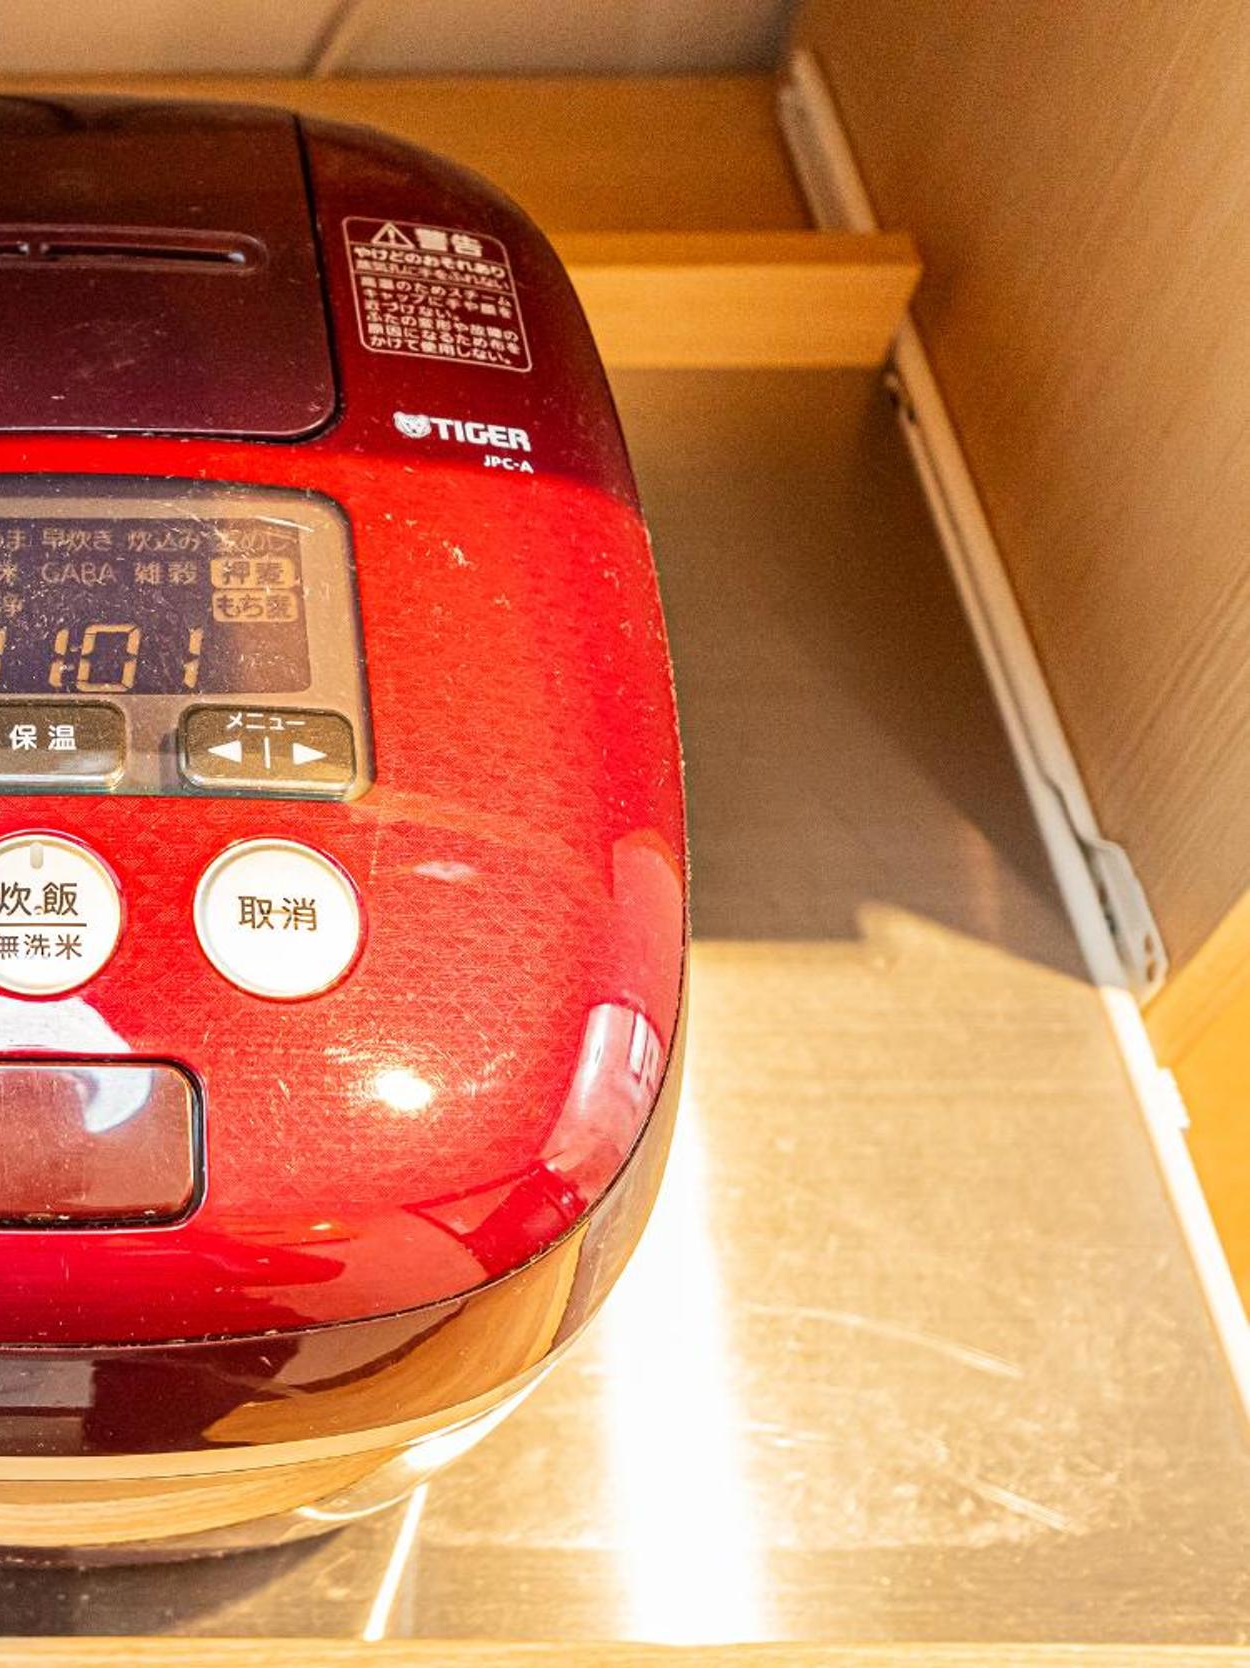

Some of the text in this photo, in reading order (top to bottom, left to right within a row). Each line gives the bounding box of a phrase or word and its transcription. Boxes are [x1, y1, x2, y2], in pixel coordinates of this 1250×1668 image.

[414, 227, 483, 257] 警告
[353, 246, 506, 278] やけどのおそれあり
[430, 416, 532, 452] TIGER
[483, 454, 534, 474] JPC-A
[42, 528, 111, 551] 早炊き
[42, 562, 117, 585] GABA
[134, 561, 199, 585] 雑穀
[222, 561, 285, 585] 押麦
[217, 594, 292, 619] もち麦
[227, 713, 306, 730] メニュー
[10, 725, 77, 750] 保温
[238, 896, 318, 932] 取消
